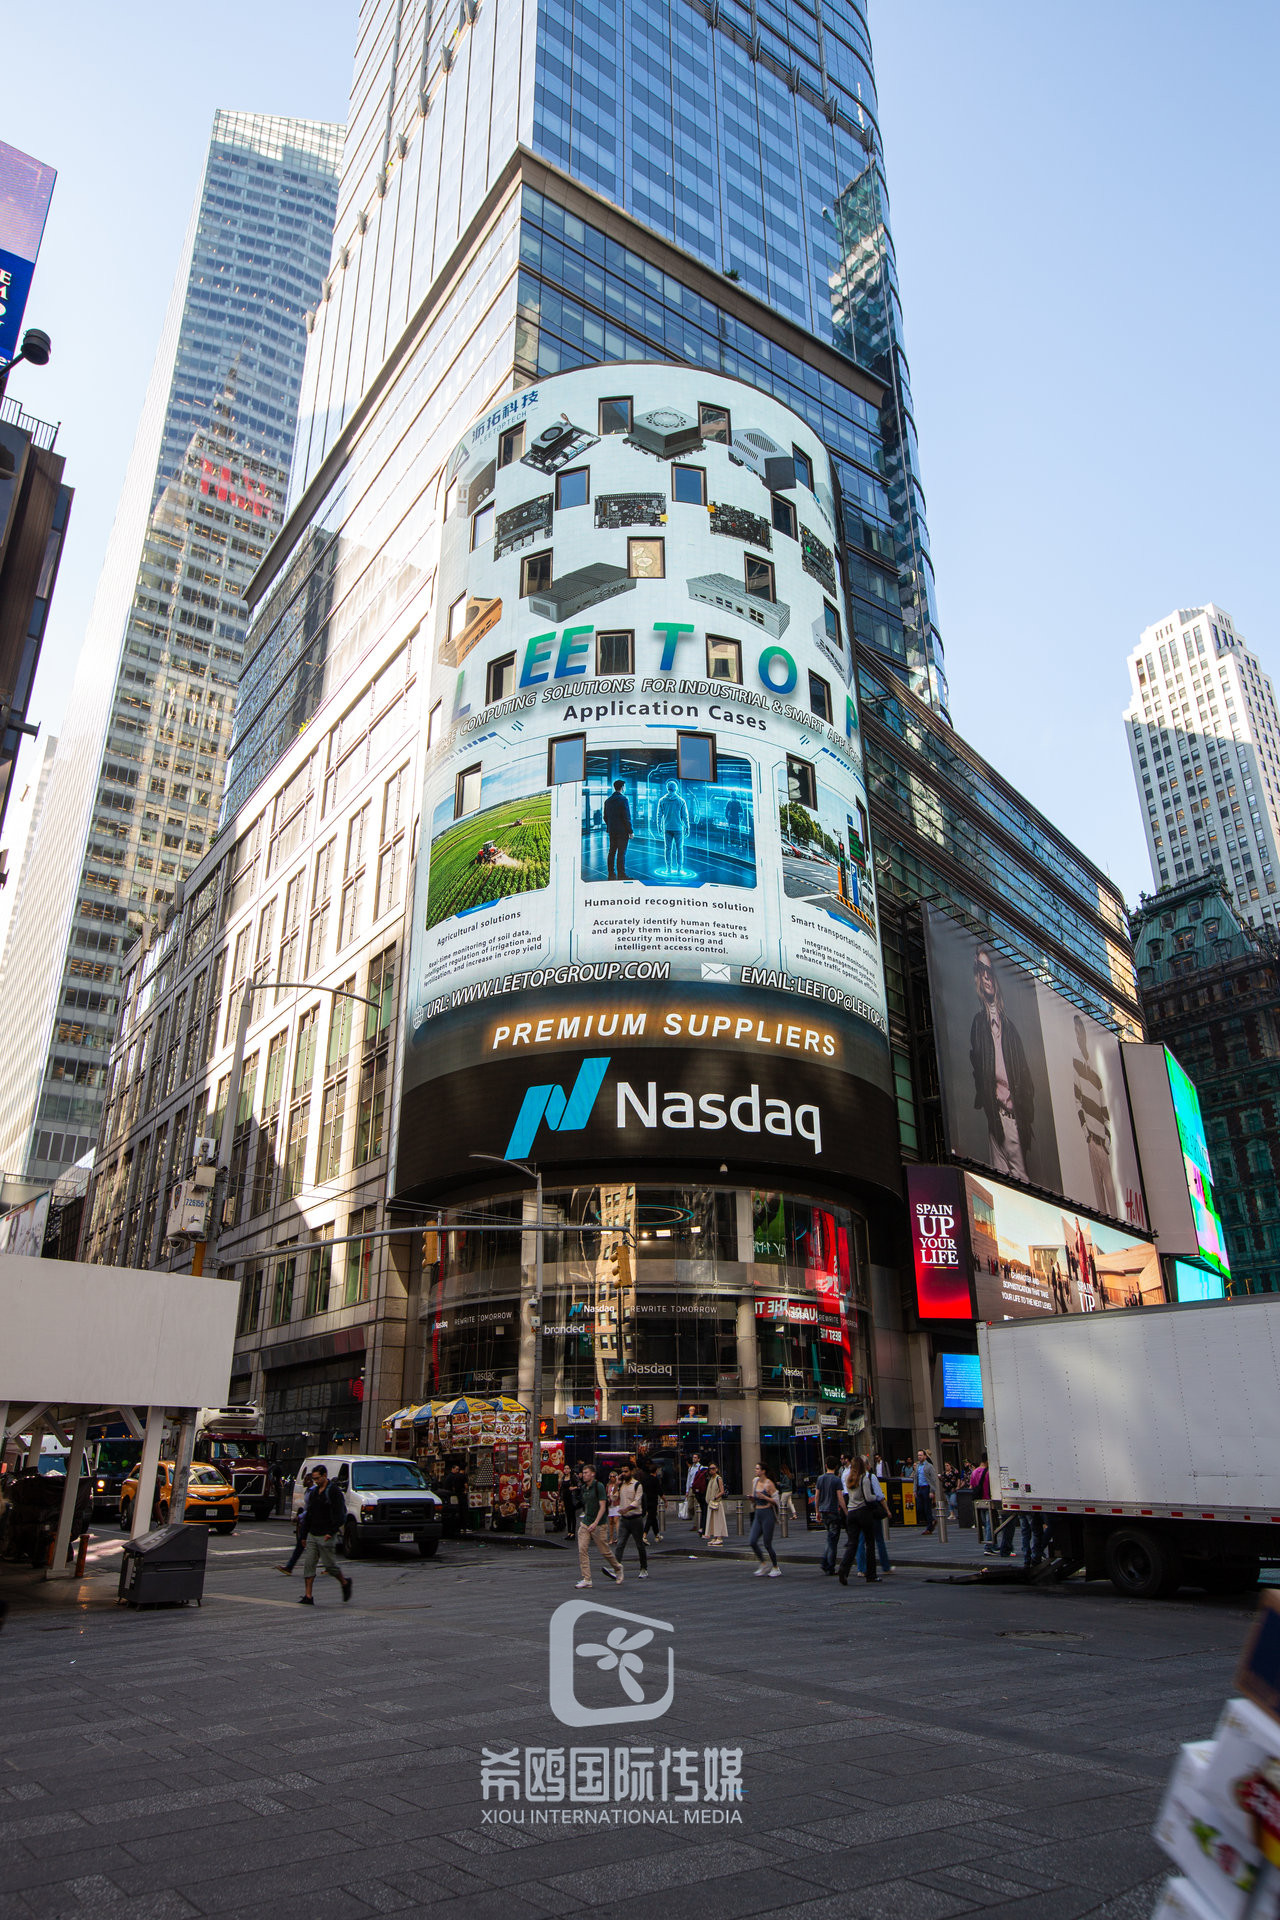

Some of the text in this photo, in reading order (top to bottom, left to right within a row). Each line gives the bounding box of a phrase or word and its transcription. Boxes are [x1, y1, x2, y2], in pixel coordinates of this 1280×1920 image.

[460, 692, 537, 736] COMPUTING
[542, 678, 635, 703] SOLUTIONS
[641, 678, 676, 693] FOR
[679, 679, 770, 711] INDUSTRIAL
[771, 699, 783, 715] &
[784, 704, 825, 735] SMART
[563, 701, 767, 731] Application Cases
[584, 897, 755, 913] Humanoid recognition solution
[437, 911, 521, 947] Agricultural solutions
[593, 917, 748, 931] Accurately identify human features
[591, 927, 608, 935] and
[611, 926, 635, 936] apply
[638, 926, 661, 934] them
[675, 927, 716, 937] scenarios
[718, 931, 738, 939] such
[617, 935, 652, 944] security
[655, 935, 705, 945] monitoring
[791, 915, 815, 929] Smart
[817, 923, 862, 952] transportation
[448, 951, 480, 968] regulation
[490, 938, 525, 953] irrigation
[526, 935, 542, 943] and
[453, 939, 487, 957] monitoring
[488, 937, 496, 945] of
[497, 932, 510, 942] soil
[614, 943, 661, 952] intelligent
[695, 946, 729, 955] control.
[804, 938, 833, 955] Integrate
[833, 949, 846, 959] road
[453, 963, 465, 973] and
[465, 954, 493, 967] increase
[503, 948, 520, 958] crop
[522, 943, 542, 955] yield
[801, 947, 826, 960] parking
[796, 953, 823, 966] enhance
[823, 961, 842, 973] traffic
[740, 966, 795, 992] EMAIL:
[426, 961, 671, 1019] URL: WWW.LEETOPGROUP.COM
[492, 1013, 836, 1057] PREMIUM SUPPLIERS
[616, 1081, 822, 1155] Nasdaq
[916, 1203, 953, 1215] SPAIN
[917, 1215, 955, 1237] UP
[919, 1237, 957, 1249] YOUR
[920, 1249, 959, 1265] LIFE
[1031, 1287, 1041, 1297] THAT
[1077, 1280, 1094, 1293] SPAIN
[1001, 1291, 1013, 1301] YOUR
[1013, 1294, 1021, 1303] LIFE
[1033, 1298, 1042, 1308] NEXT
[1078, 1292, 1096, 1312] UP
[477, 1311, 513, 1322] TOMORROW
[583, 1305, 615, 1314] Nasdaq
[630, 1305, 718, 1313] REWRITE TOMORROW
[628, 1362, 672, 1376] Nasdaq
[782, 1367, 804, 1378] Nasdaq
